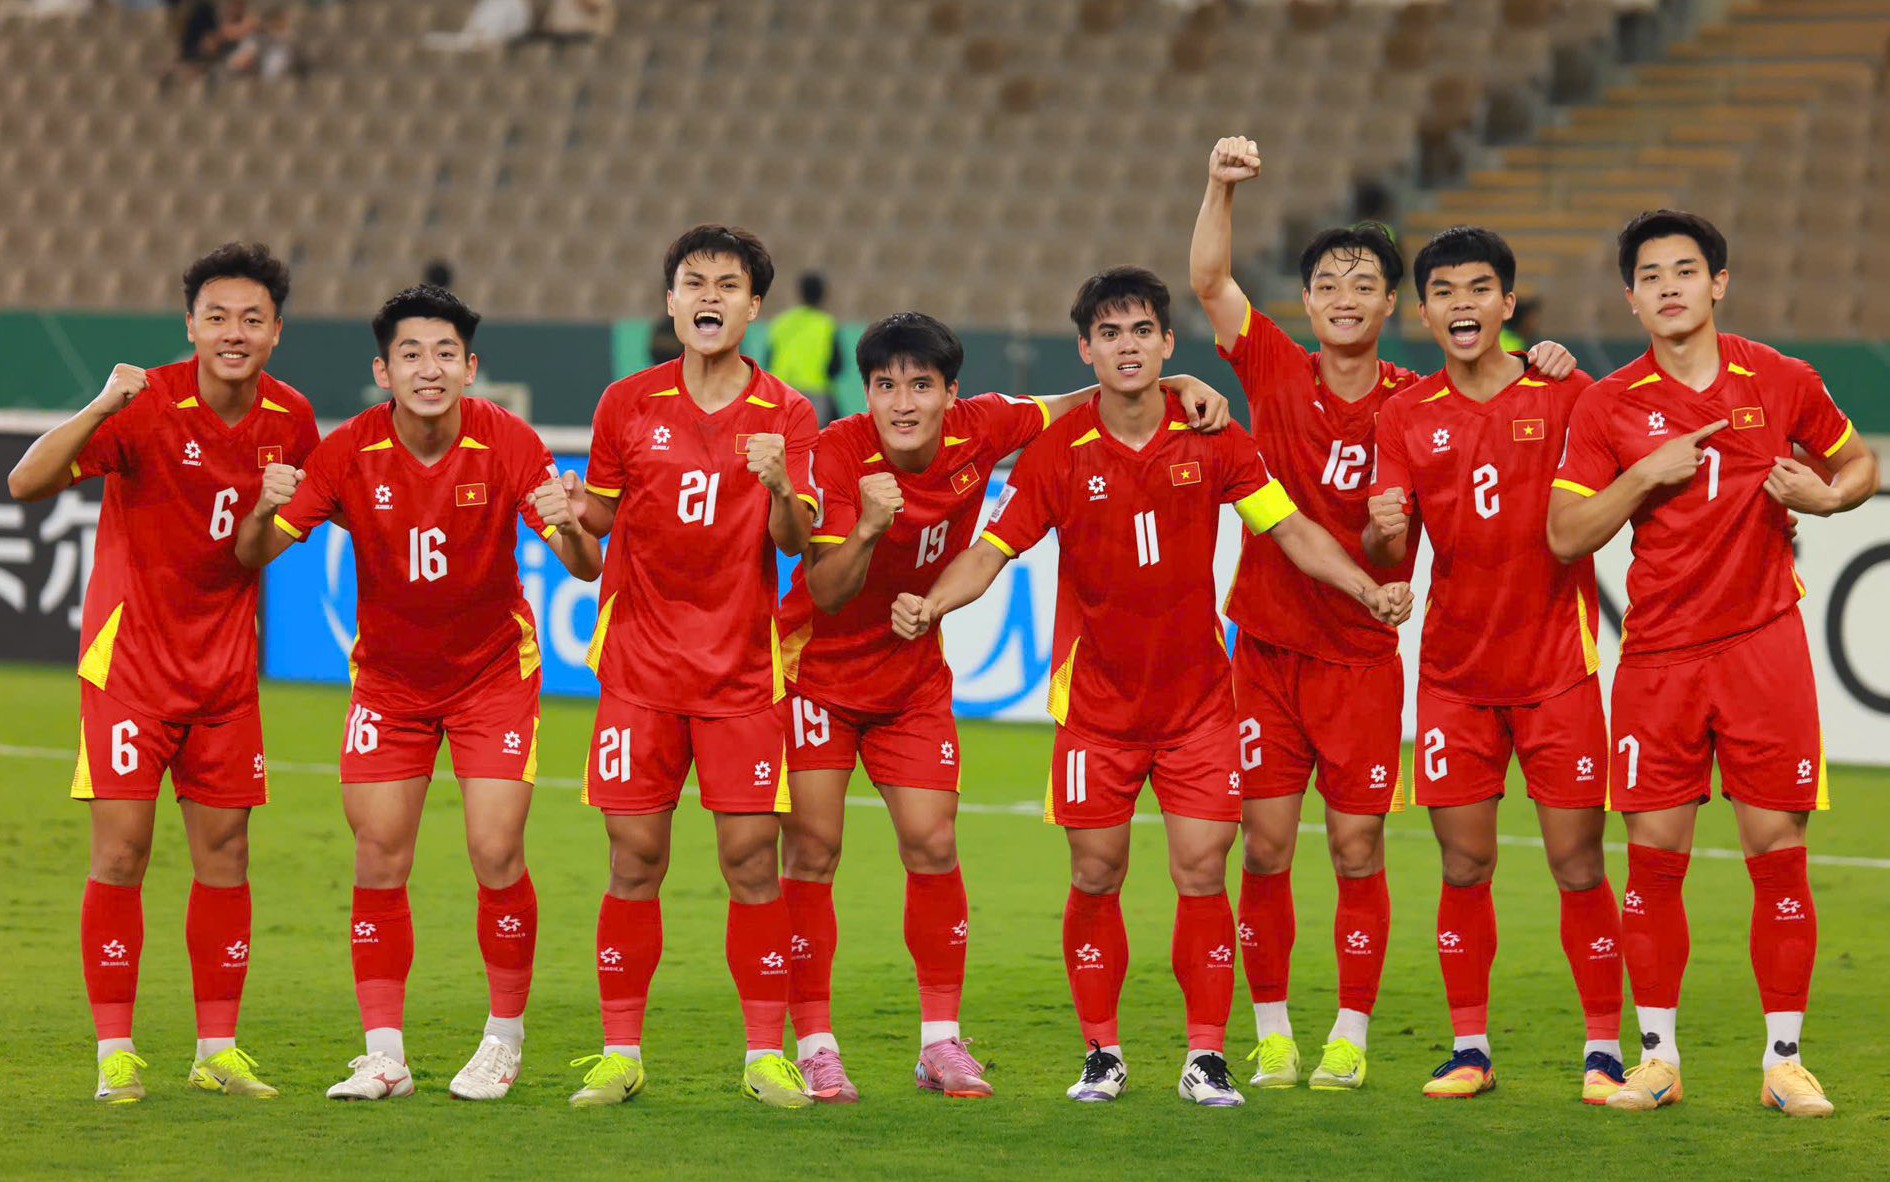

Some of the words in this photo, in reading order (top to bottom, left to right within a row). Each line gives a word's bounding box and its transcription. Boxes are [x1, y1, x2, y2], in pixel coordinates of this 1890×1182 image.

[1321, 440, 1367, 491] 12
[1472, 463, 1500, 519] 2
[1698, 446, 1721, 501] 7
[209, 486, 239, 541] 6
[677, 469, 721, 526] 21
[409, 526, 448, 582] 16
[915, 519, 949, 569] 19
[1133, 510, 1160, 567] 11
[111, 719, 139, 776] 6
[345, 703, 383, 754] 16
[792, 695, 830, 749] 19
[598, 726, 631, 783] 21
[1066, 748, 1087, 804] 11
[1424, 727, 1448, 782] 2
[1618, 734, 1640, 790] 7
